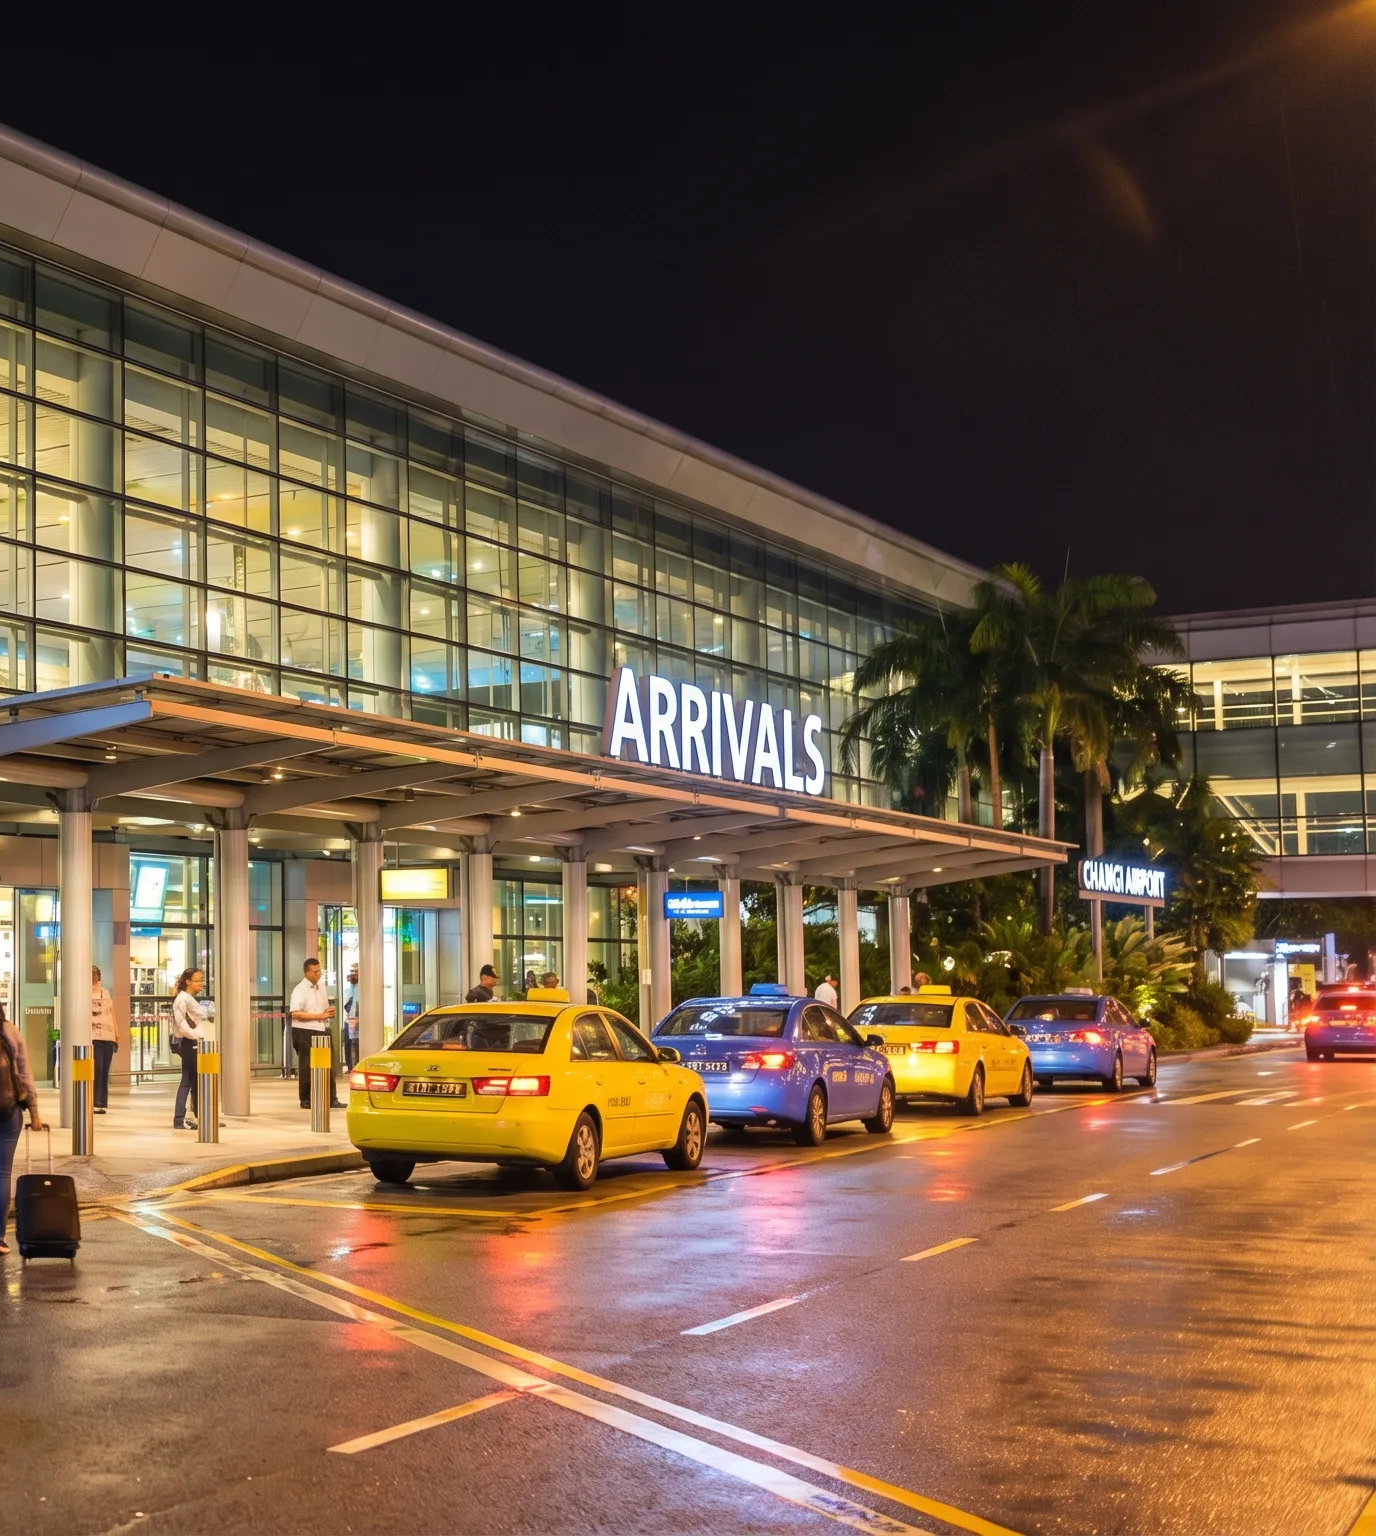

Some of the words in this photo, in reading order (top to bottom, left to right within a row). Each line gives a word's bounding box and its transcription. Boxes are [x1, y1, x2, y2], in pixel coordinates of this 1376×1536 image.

[608, 666, 825, 796] ARRIVALS
[1083, 860, 1124, 894] CHANGI
[1125, 866, 1165, 898] AIRPORT
